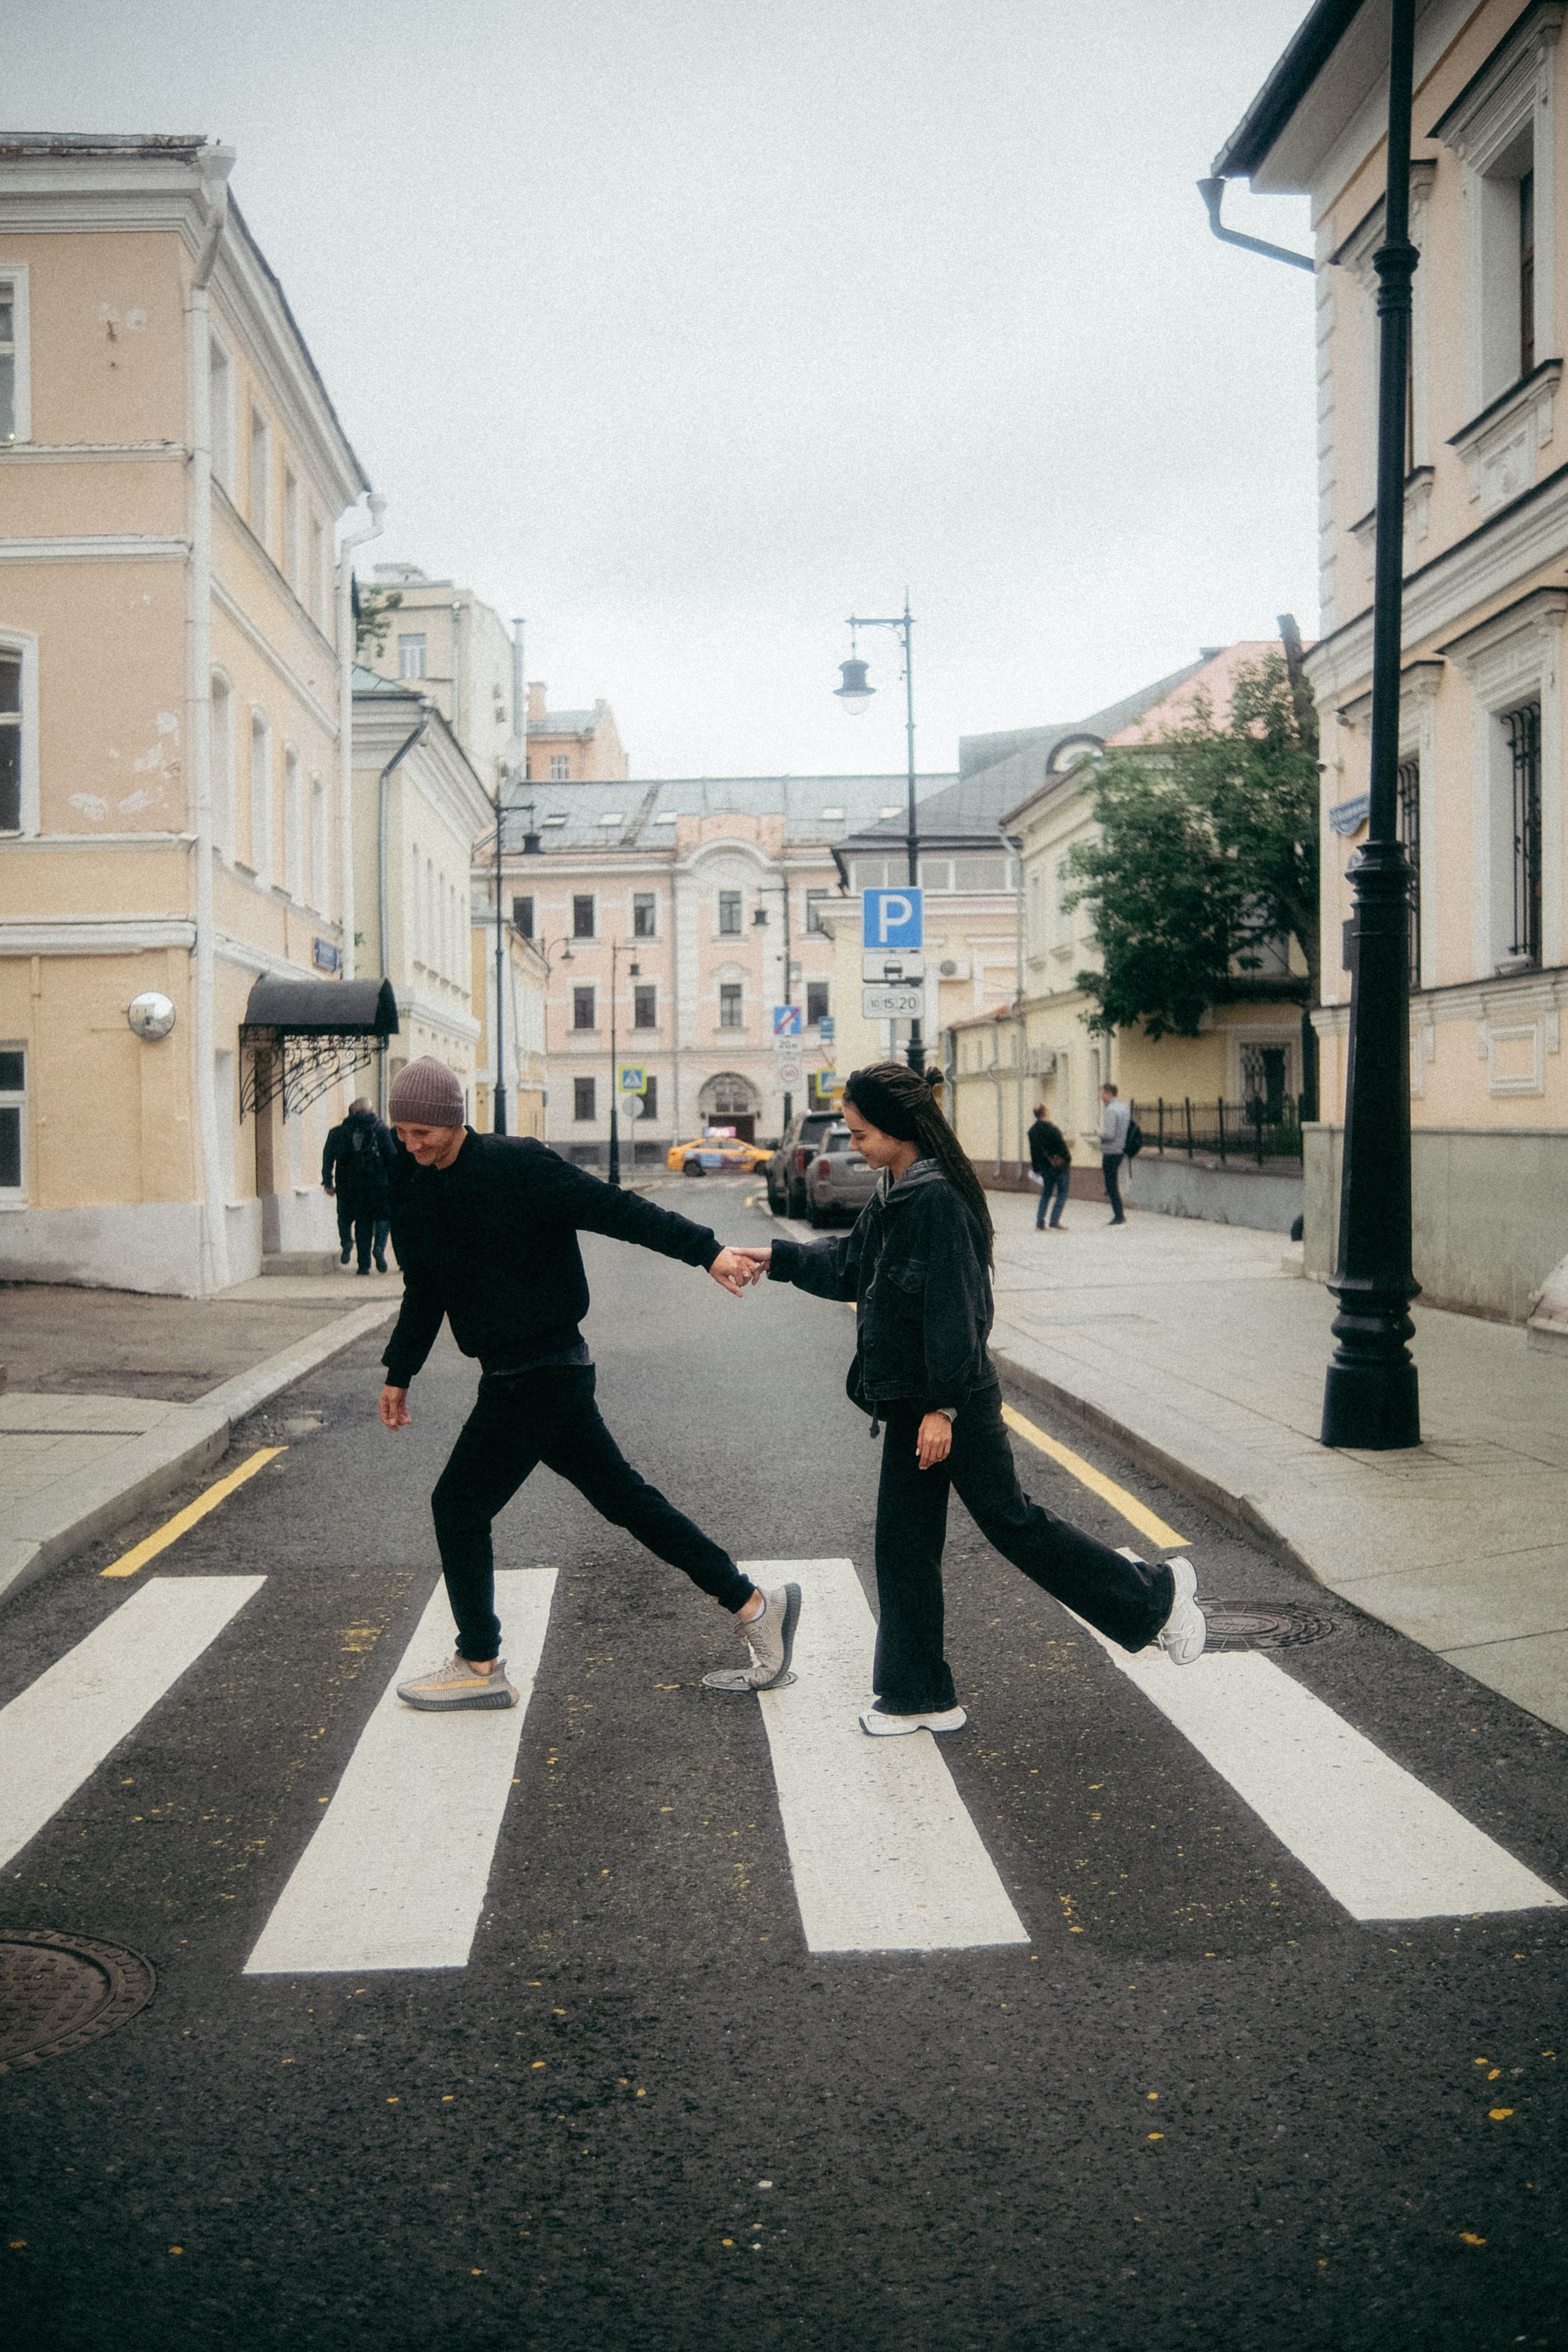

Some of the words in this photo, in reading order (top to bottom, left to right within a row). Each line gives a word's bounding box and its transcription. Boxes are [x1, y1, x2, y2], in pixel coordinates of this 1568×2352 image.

[879, 894, 912, 943] P
[871, 999, 880, 1008] 10
[884, 998, 894, 1009] 15
[899, 997, 917, 1009] 20
